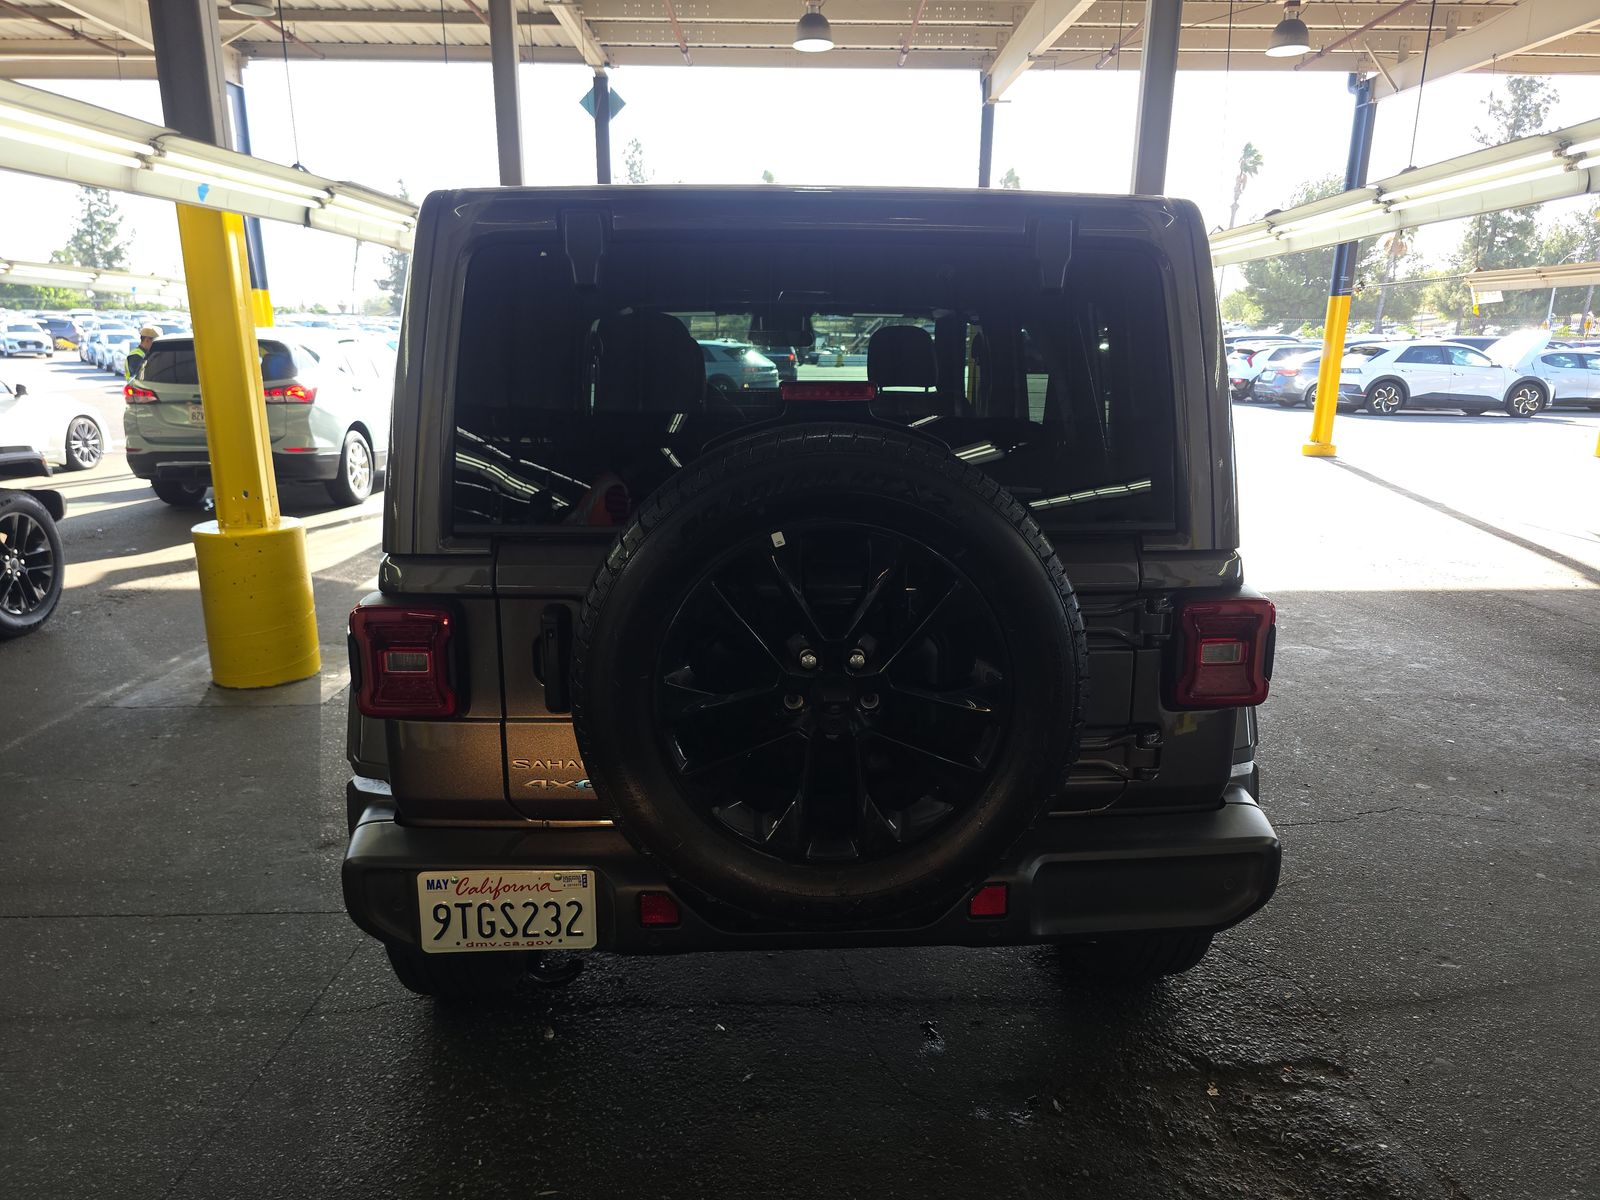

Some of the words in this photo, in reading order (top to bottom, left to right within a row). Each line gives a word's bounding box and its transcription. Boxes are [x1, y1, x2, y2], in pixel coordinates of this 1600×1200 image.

[512, 758, 584, 769] SAHA
[426, 879, 449, 890] MAY
[456, 877, 562, 900] California
[432, 901, 584, 941] 9TGS232
[466, 939, 554, 948] dmv.ca.gov
